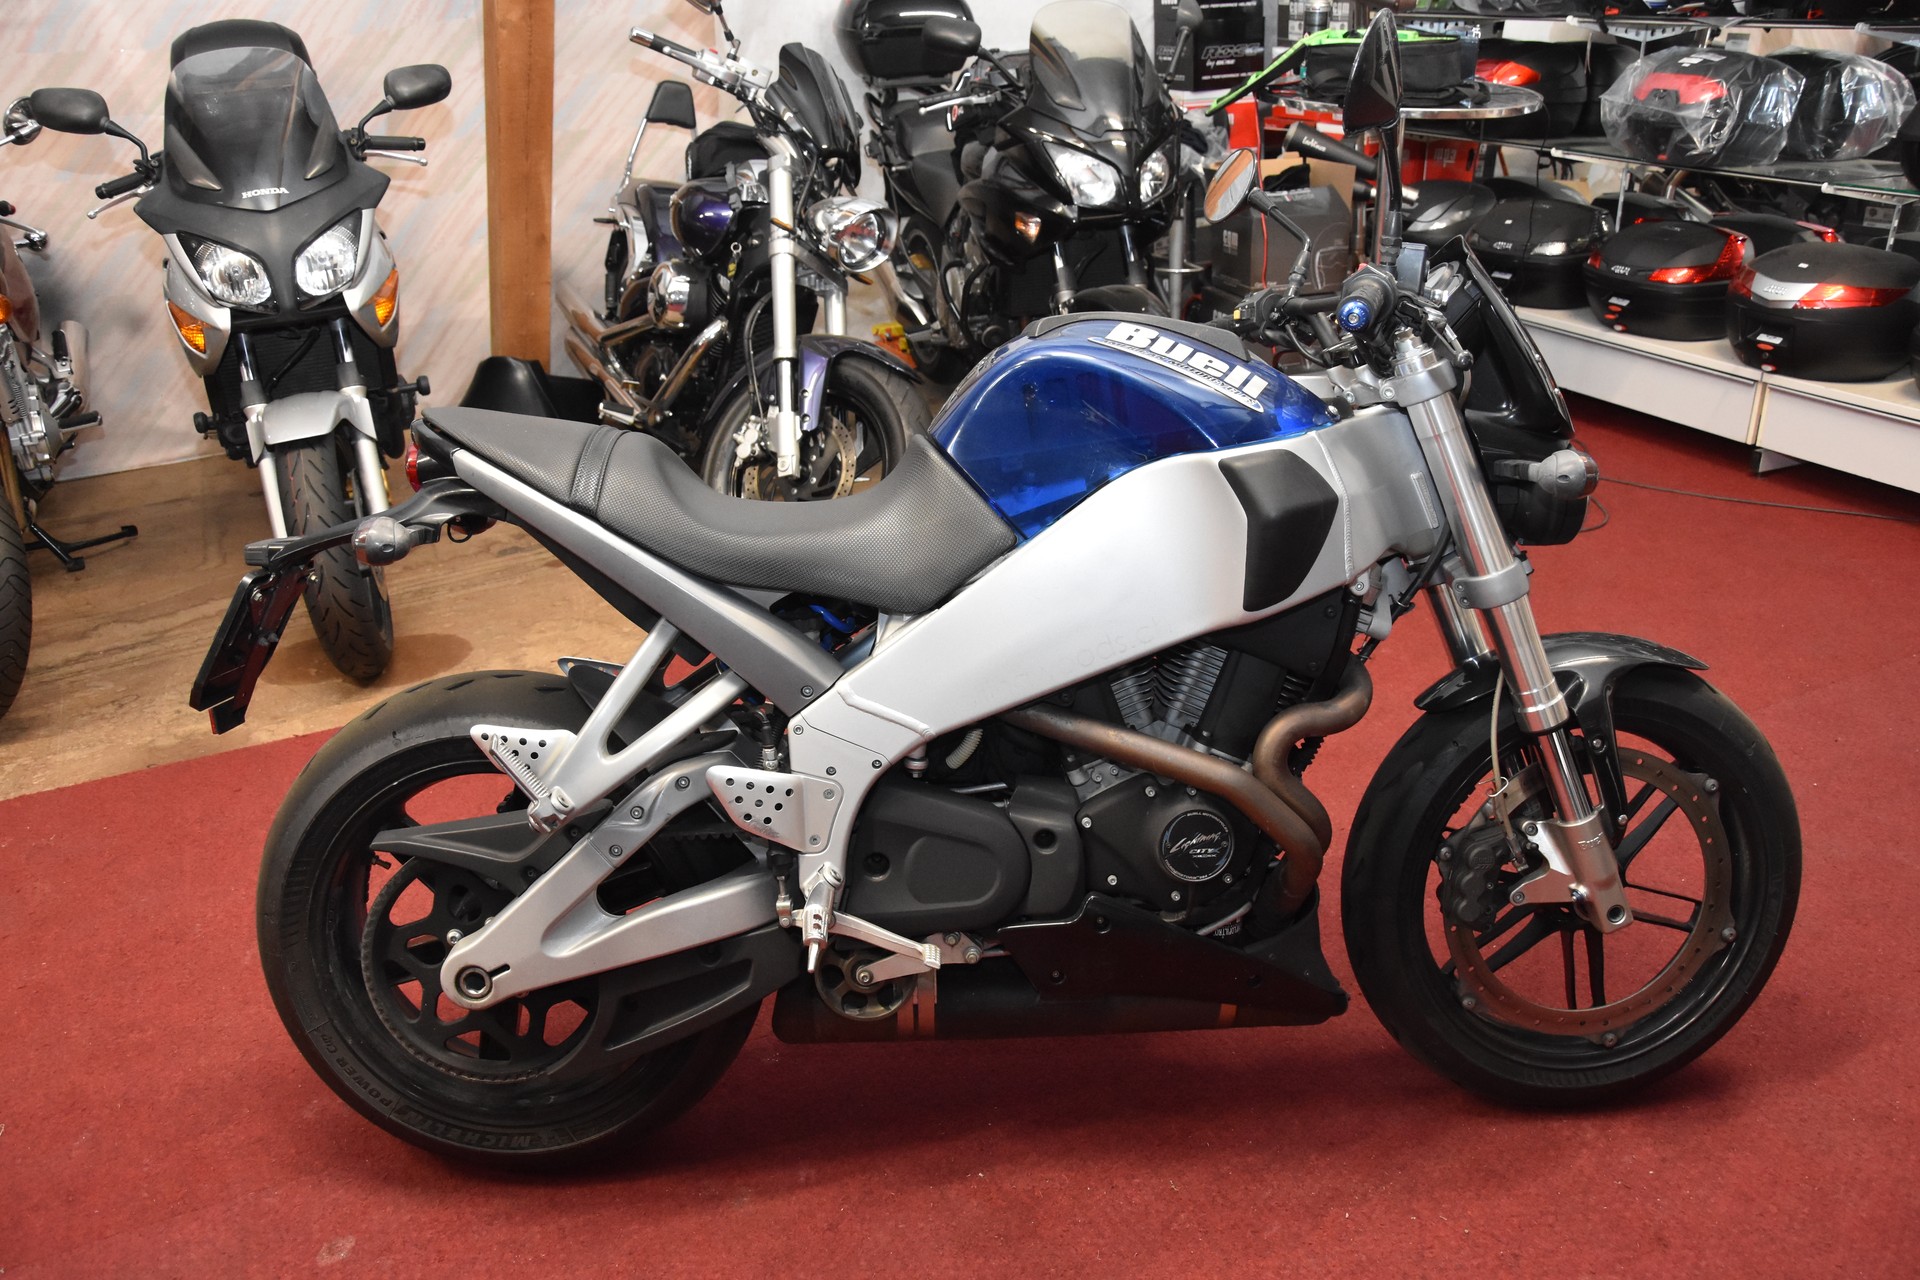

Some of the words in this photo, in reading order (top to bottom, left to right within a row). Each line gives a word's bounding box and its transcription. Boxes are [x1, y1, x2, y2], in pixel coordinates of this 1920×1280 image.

[241, 187, 289, 199] HONDA
[1104, 321, 1270, 400] Buell
[334, 1055, 393, 1108] POWER
[401, 1104, 531, 1148] MICHELIN
